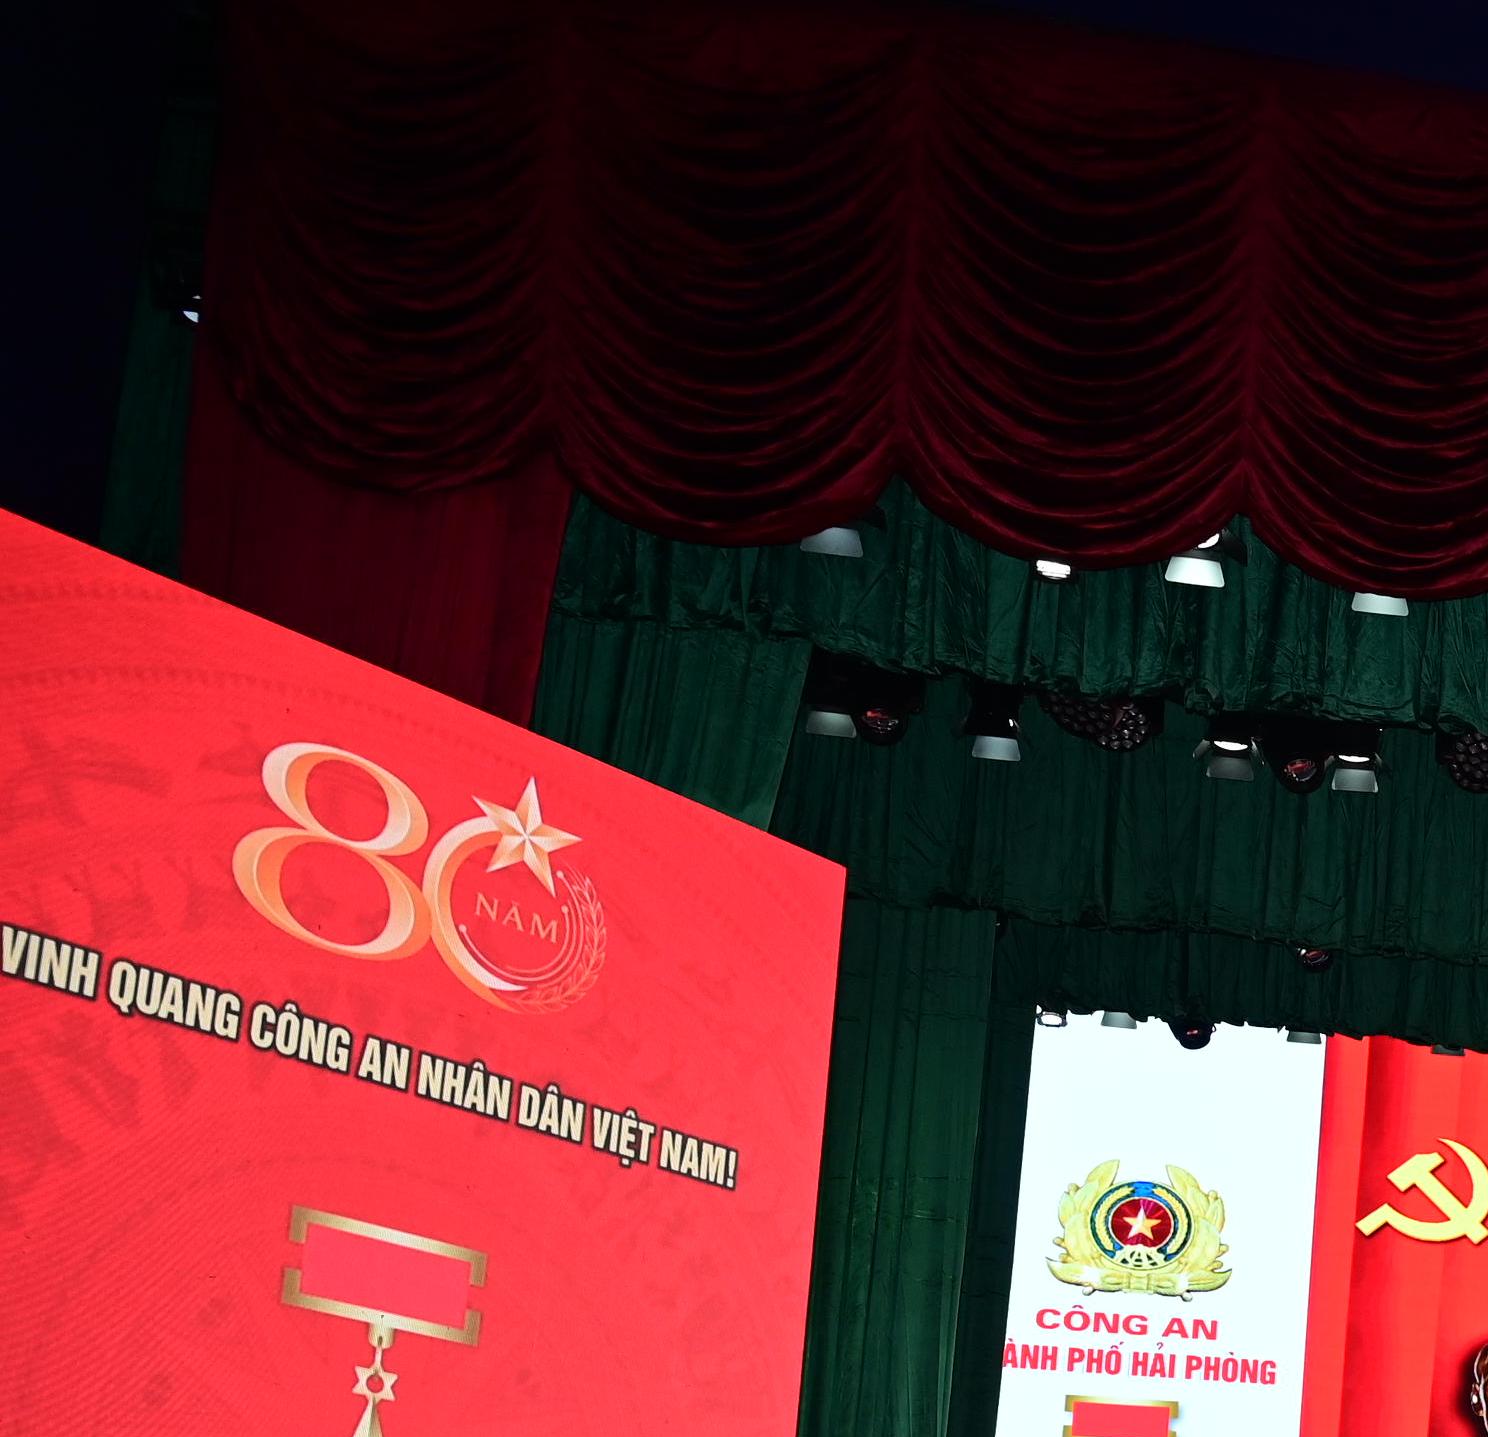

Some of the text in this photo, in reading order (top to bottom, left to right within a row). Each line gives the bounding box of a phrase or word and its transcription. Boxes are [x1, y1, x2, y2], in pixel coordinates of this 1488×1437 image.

[2, 926, 737, 1188] VINH QUANG CÔNG AN NHÂN DÂN VIỆT NAM!
[1035, 1304, 1219, 1341] CÔNG AN
[1066, 1341, 1123, 1376] PHỐ
[1131, 1342, 1177, 1379] HẢI
[1184, 1354, 1277, 1385] PHÒNG
